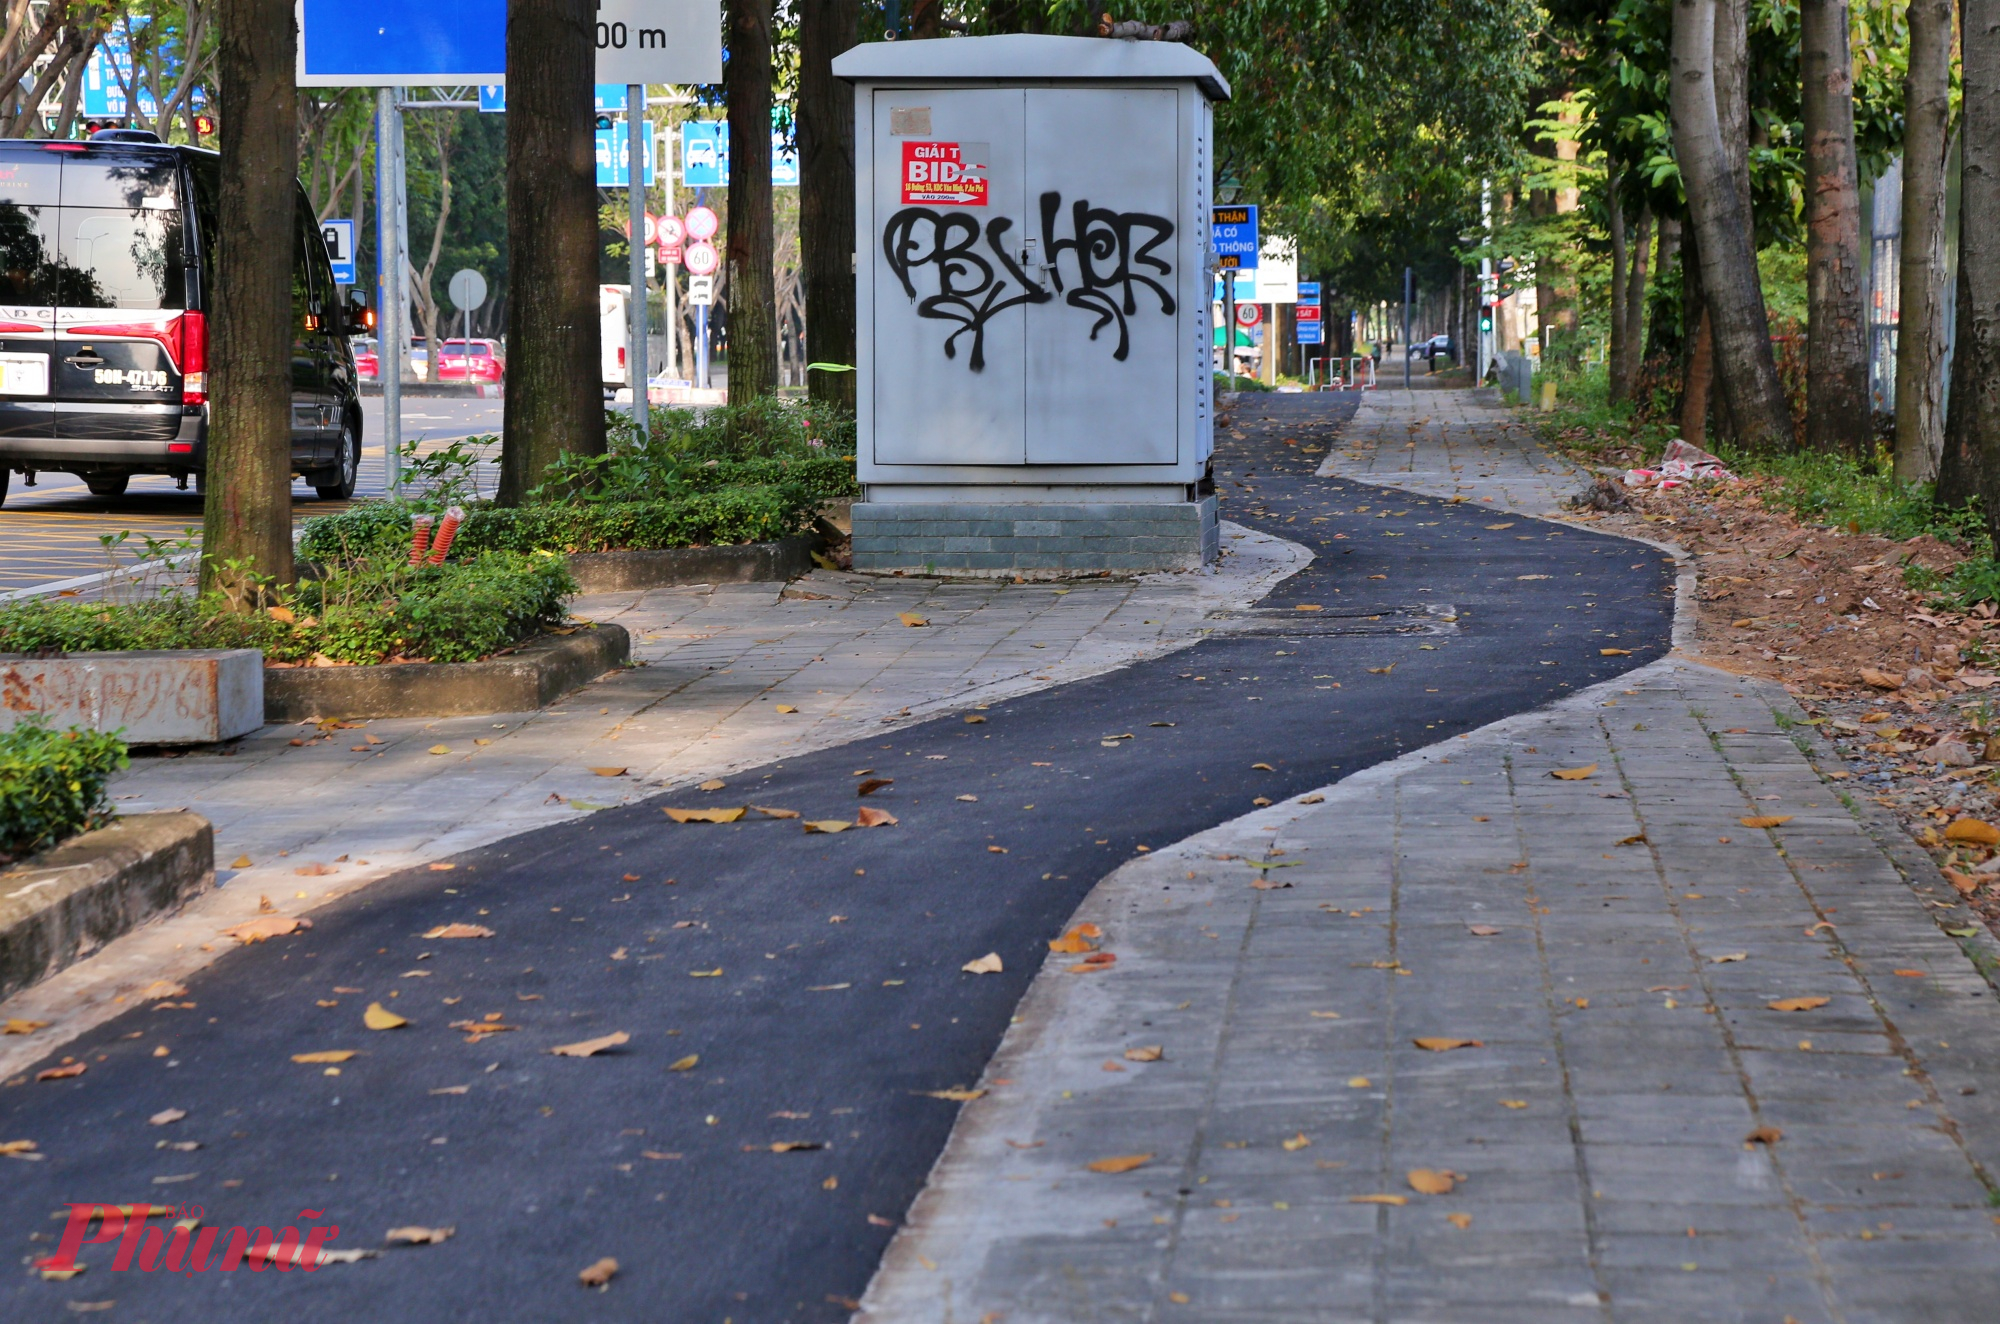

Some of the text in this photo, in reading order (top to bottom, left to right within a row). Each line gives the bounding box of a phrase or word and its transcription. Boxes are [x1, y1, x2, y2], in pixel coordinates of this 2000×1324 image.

[595, 22, 666, 49] 00 m
[914, 143, 960, 158] GIẢI T
[909, 161, 981, 184] BIDA
[1218, 211, 1246, 223] THẬN
[1224, 225, 1238, 238] CÓ
[1219, 241, 1254, 252] THÔNG
[693, 251, 709, 265] 60
[1220, 256, 1238, 268] ƯỜI
[1242, 308, 1254, 319] 60
